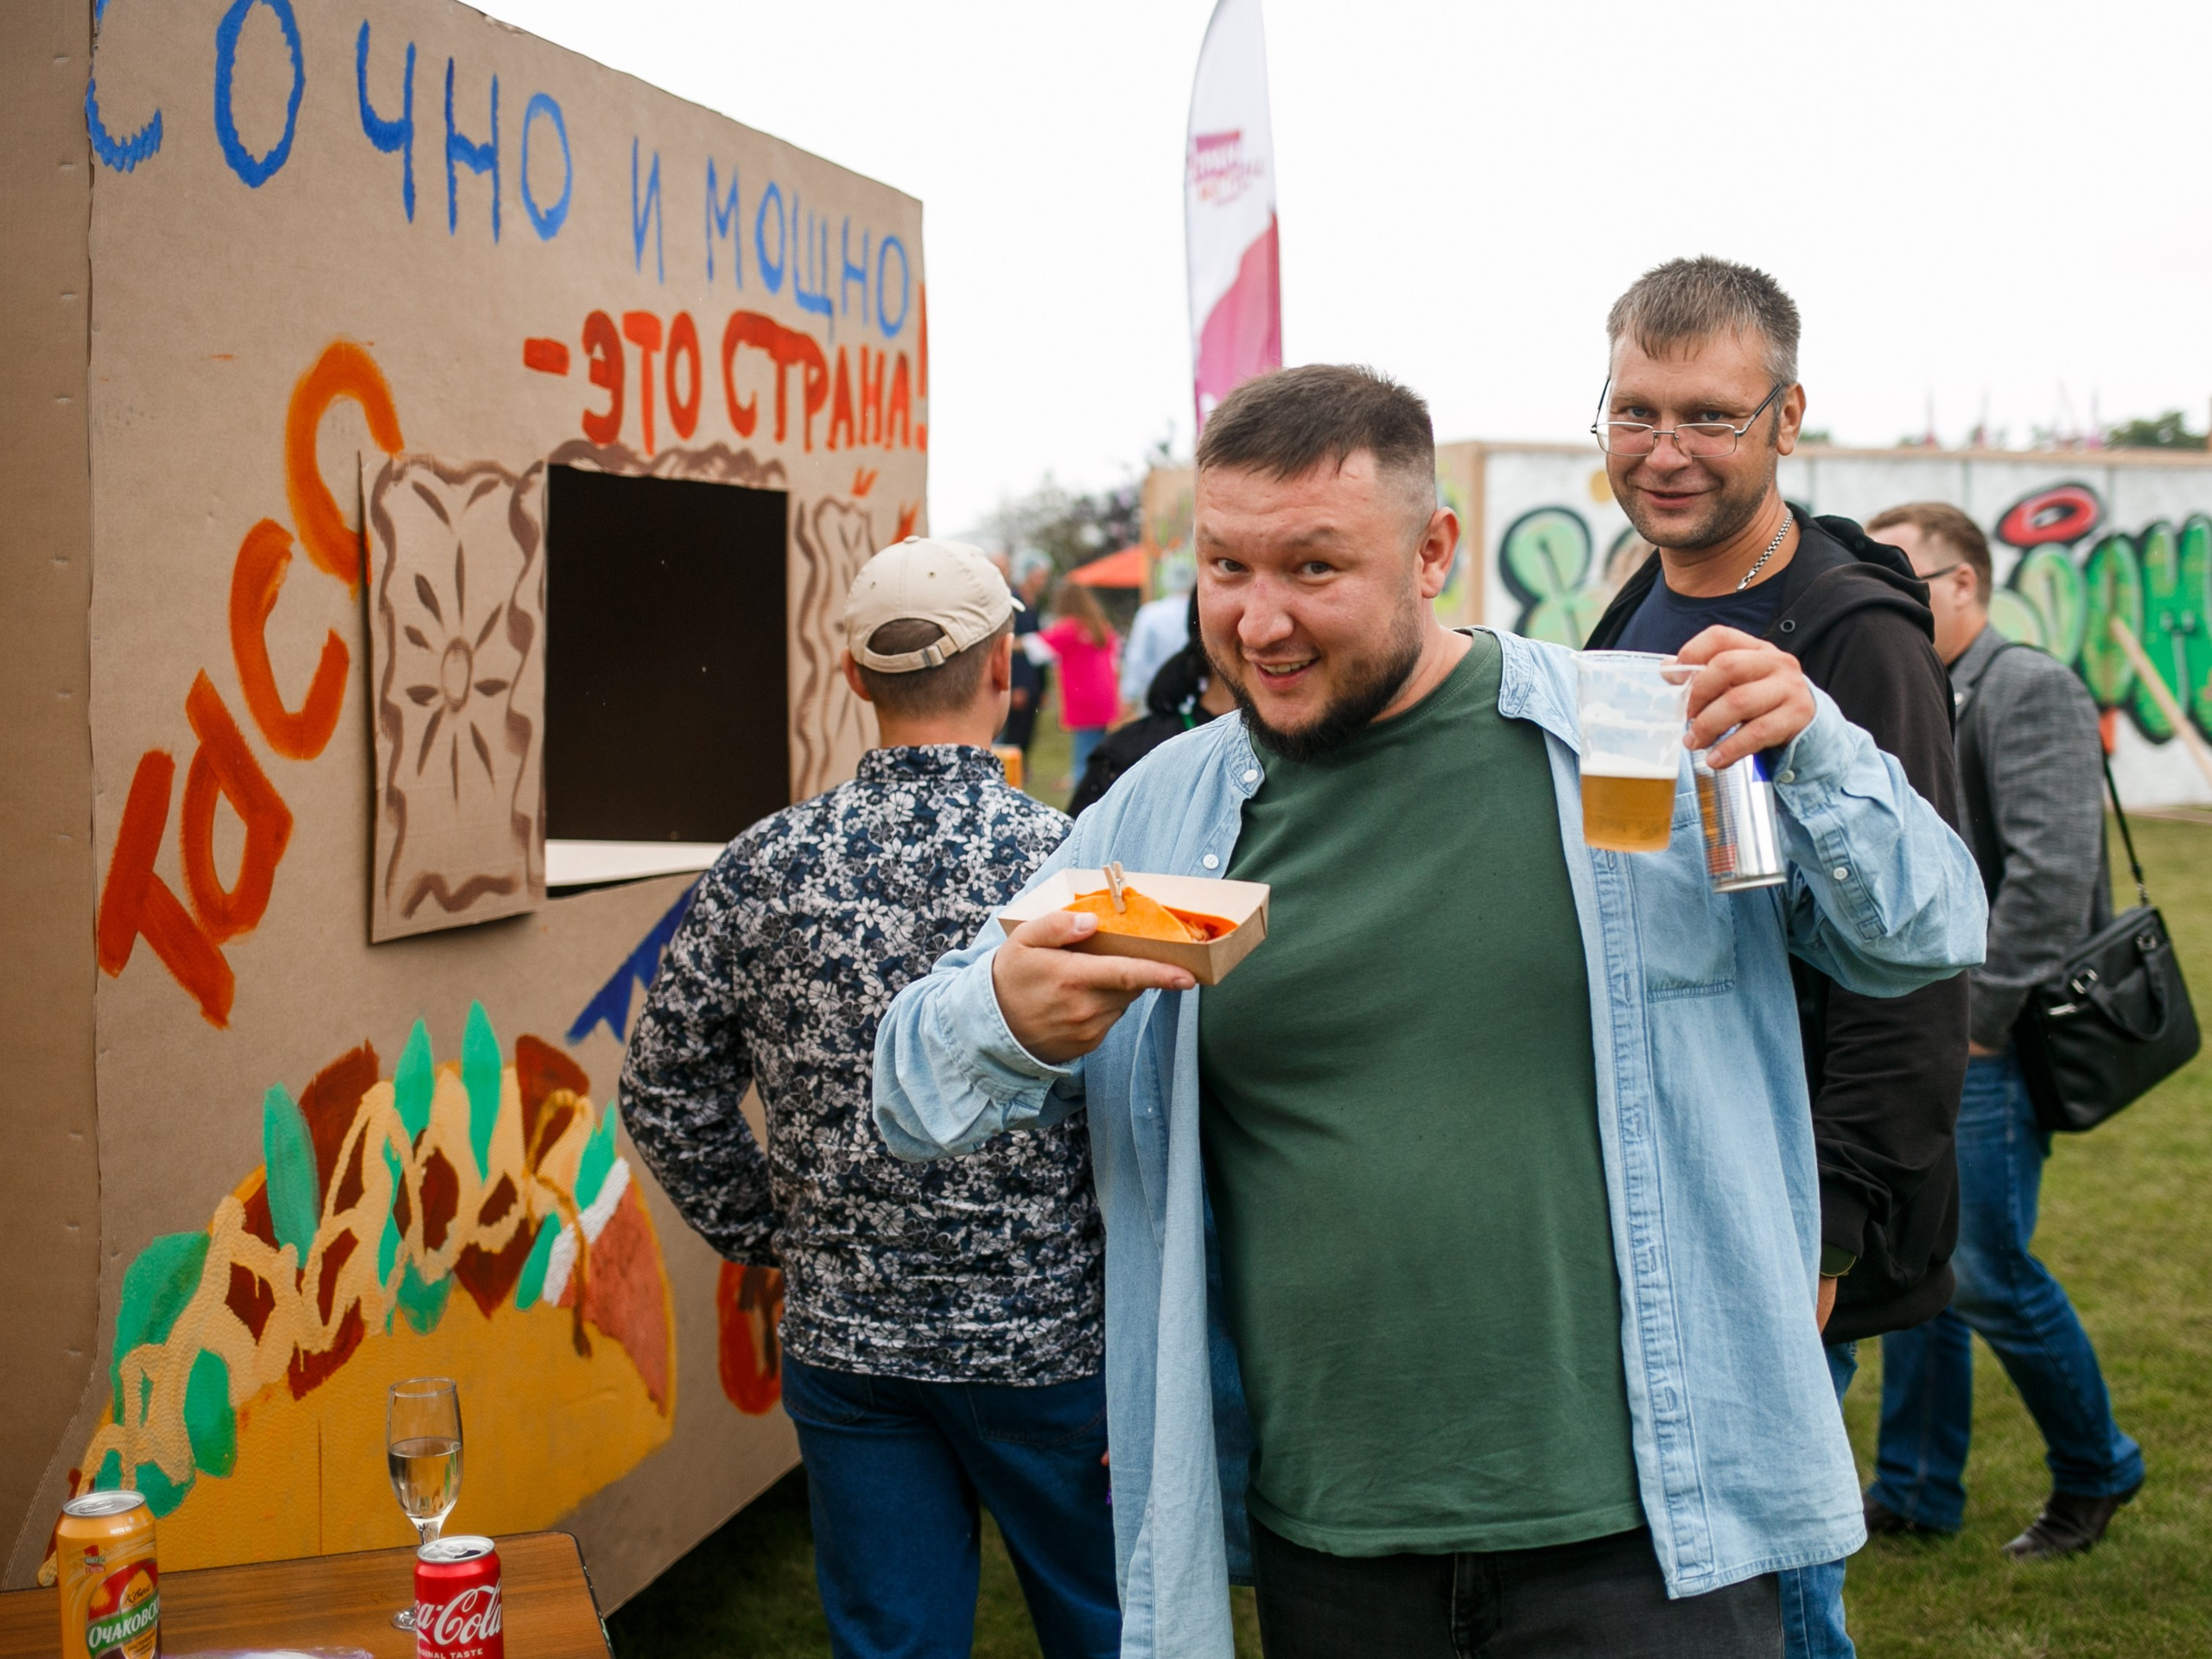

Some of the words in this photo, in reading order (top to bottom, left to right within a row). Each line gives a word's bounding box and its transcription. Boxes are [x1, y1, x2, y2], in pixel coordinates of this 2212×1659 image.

[632, 136, 664, 285] И
[706, 156, 910, 344] МОЩНО
[449, 1648, 484, 1659] TASTE
